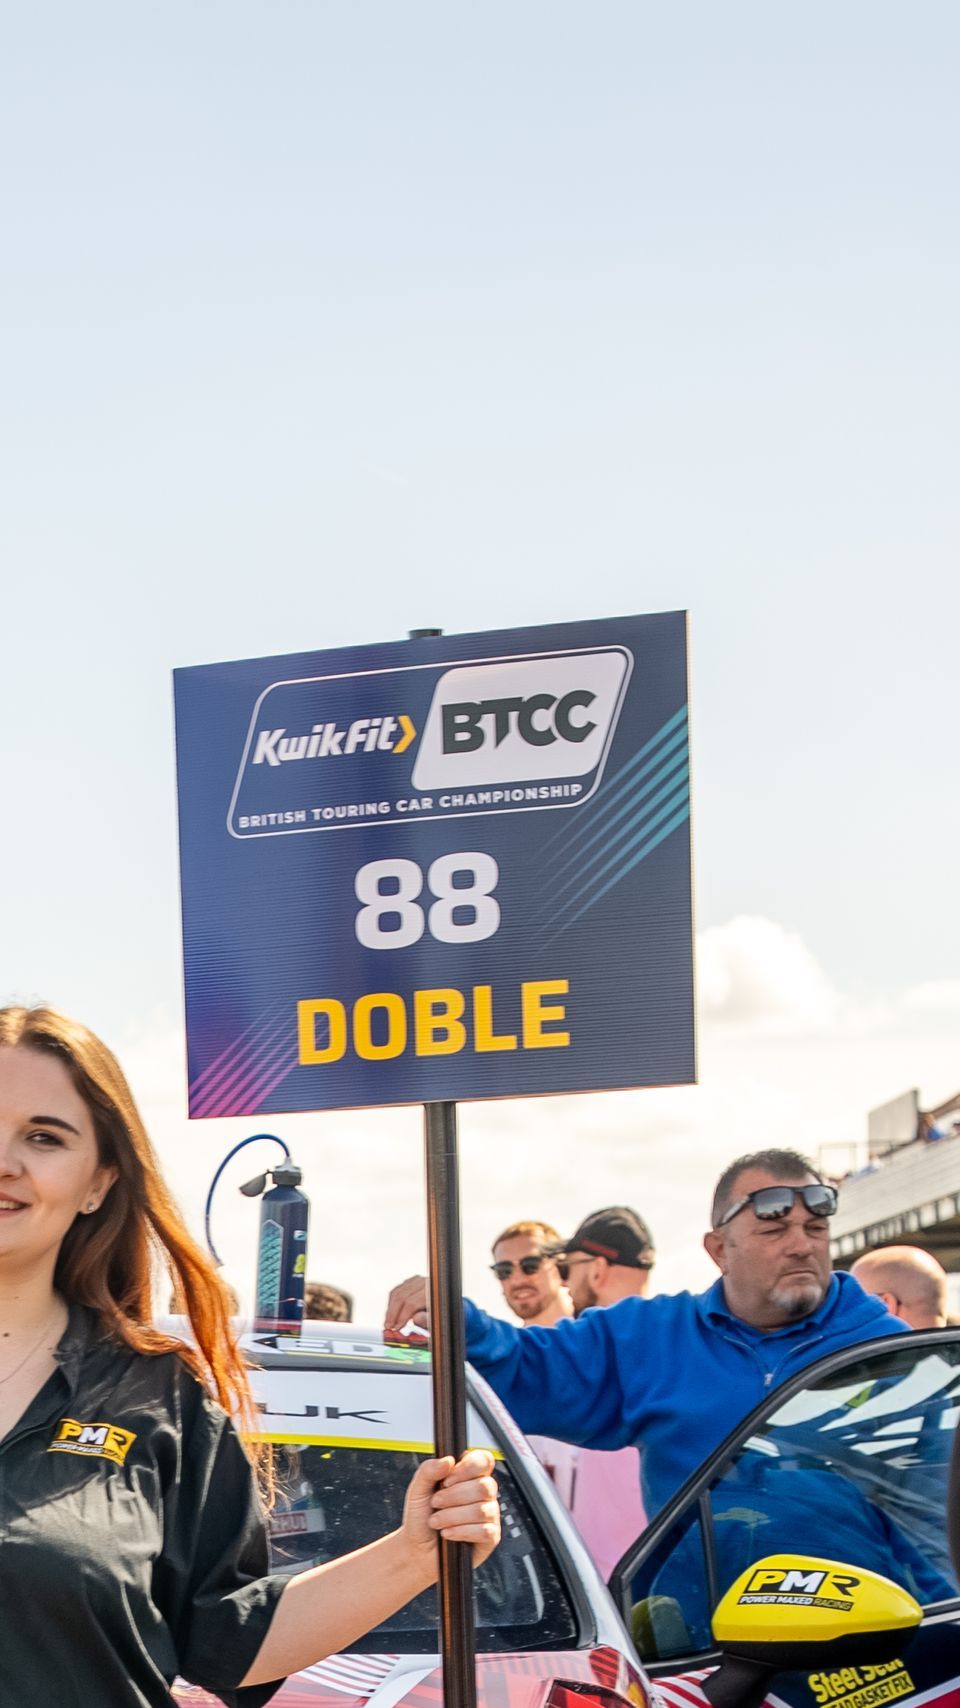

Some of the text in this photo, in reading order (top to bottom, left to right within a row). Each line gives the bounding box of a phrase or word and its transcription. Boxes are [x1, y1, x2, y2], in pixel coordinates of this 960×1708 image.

[441, 690, 597, 754] BTCC
[239, 784, 583, 828] BRITISH TOURING CAR CHAMPIONSHIP
[355, 852, 501, 949] 88
[297, 979, 570, 1065] DOBLE
[57, 1422, 128, 1456] PMR
[746, 1570, 861, 1597] PMR
[740, 1595, 851, 1610] POWER MAXED RACING
[808, 1666, 864, 1703] Steel
[893, 1674, 913, 1693] FIX
